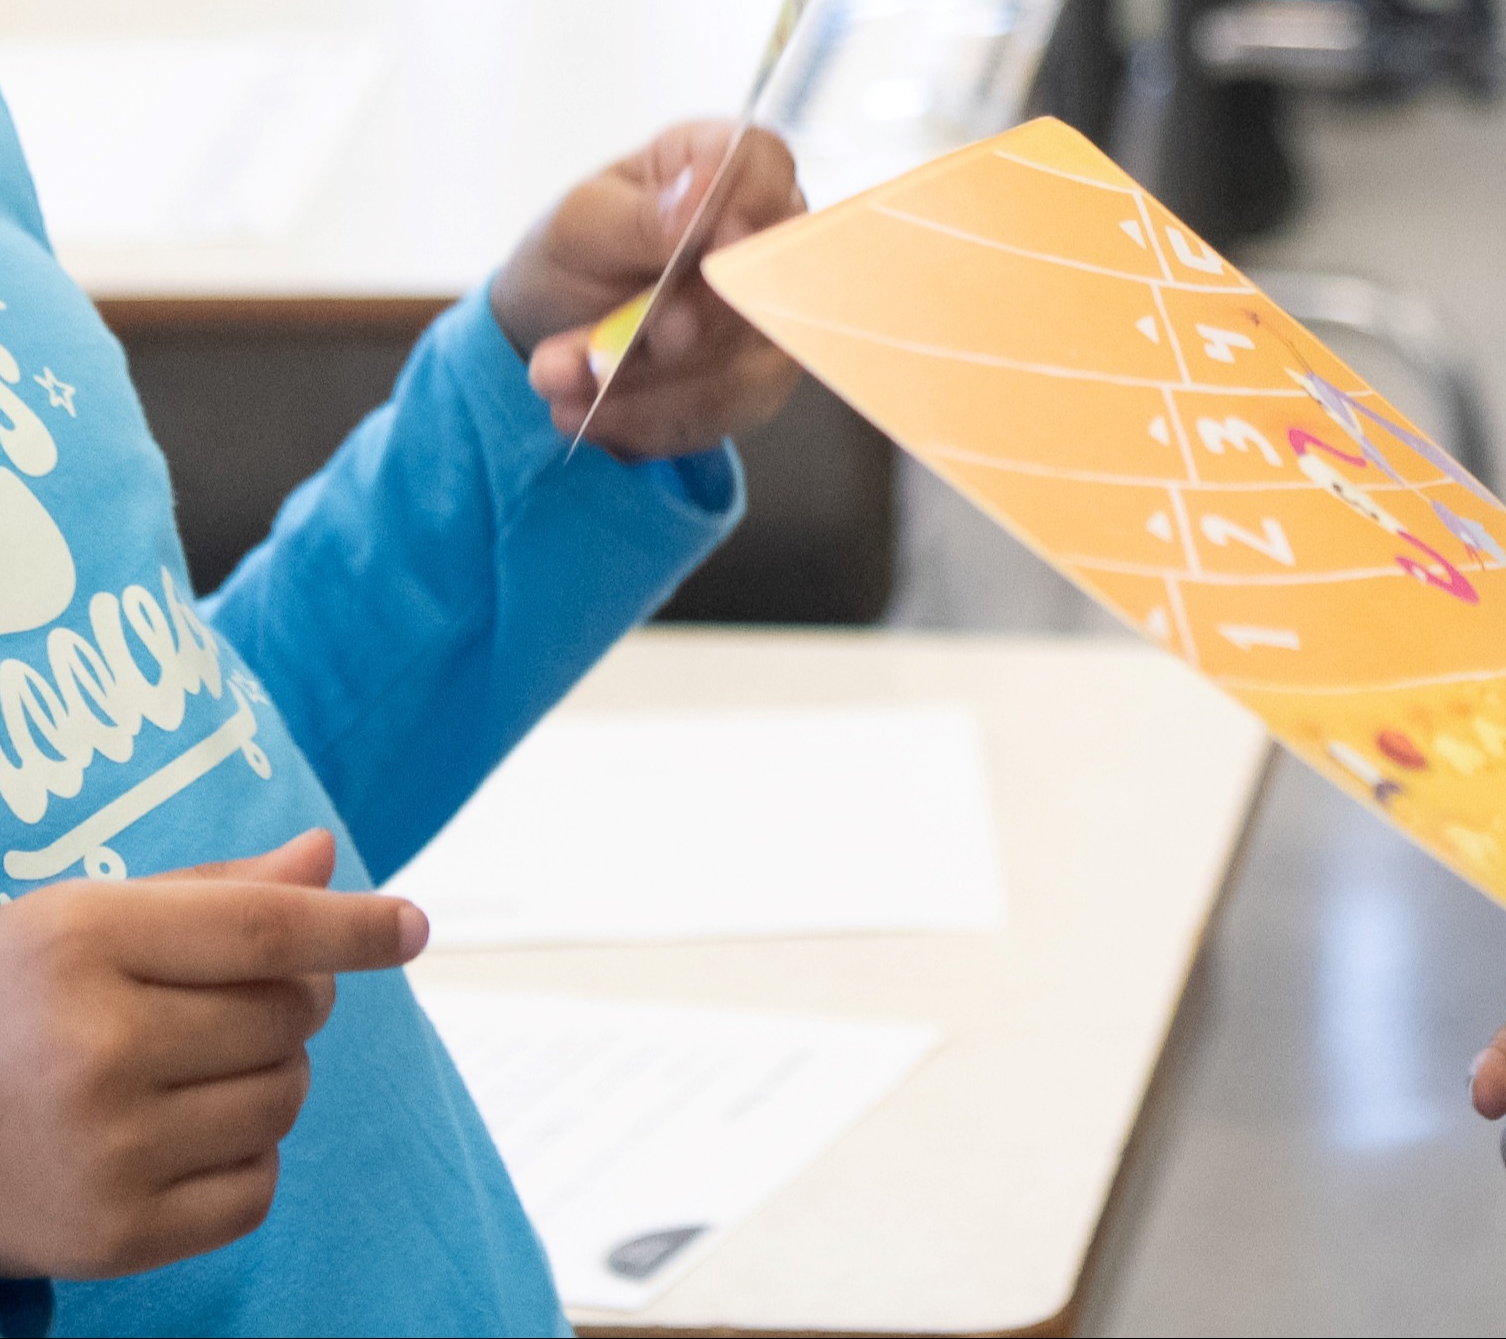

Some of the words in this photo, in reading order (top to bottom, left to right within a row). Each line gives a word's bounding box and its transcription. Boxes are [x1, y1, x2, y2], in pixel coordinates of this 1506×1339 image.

[1195, 323, 1257, 364] 4
[1197, 416, 1282, 468] 3
[1200, 512, 1295, 567] 2
[1217, 623, 1301, 651] 1
